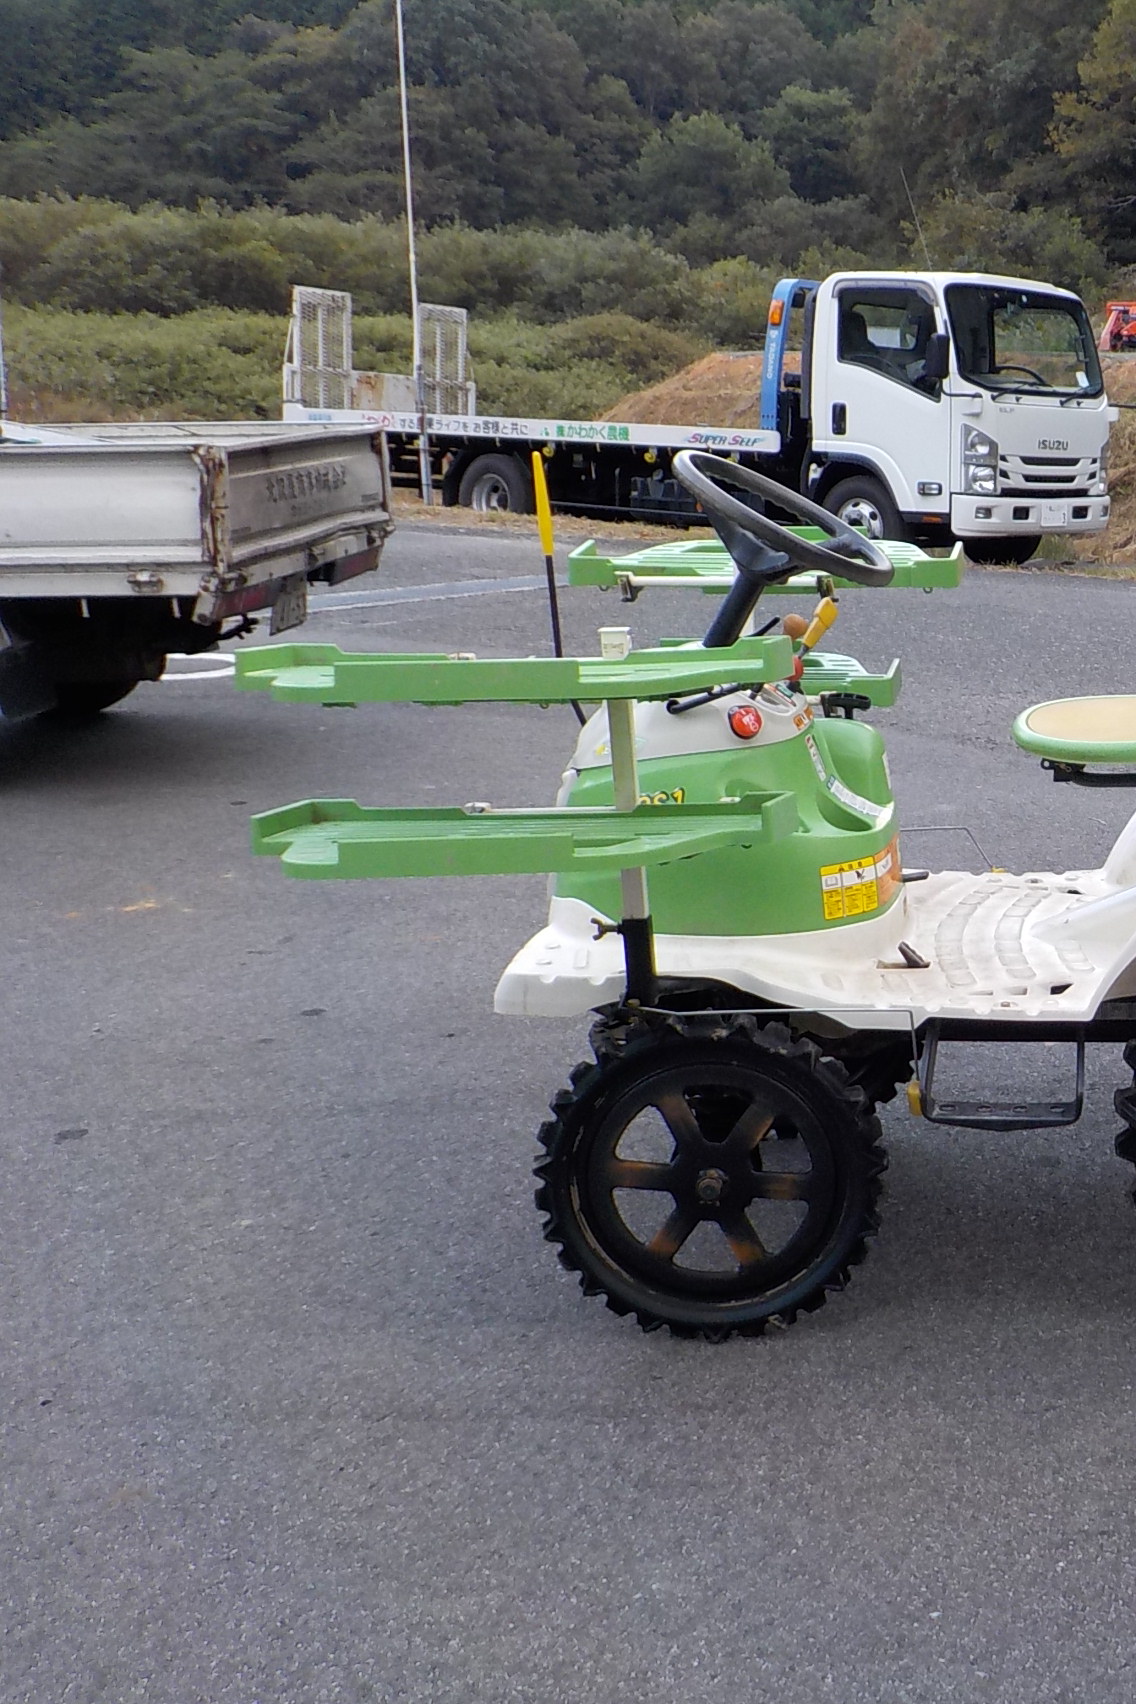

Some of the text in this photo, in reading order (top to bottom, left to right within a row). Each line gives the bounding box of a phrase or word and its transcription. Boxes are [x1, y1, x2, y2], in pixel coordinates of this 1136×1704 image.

[688, 432, 759, 447] SUPER SELF
[1038, 439, 1069, 451] ISUZU
